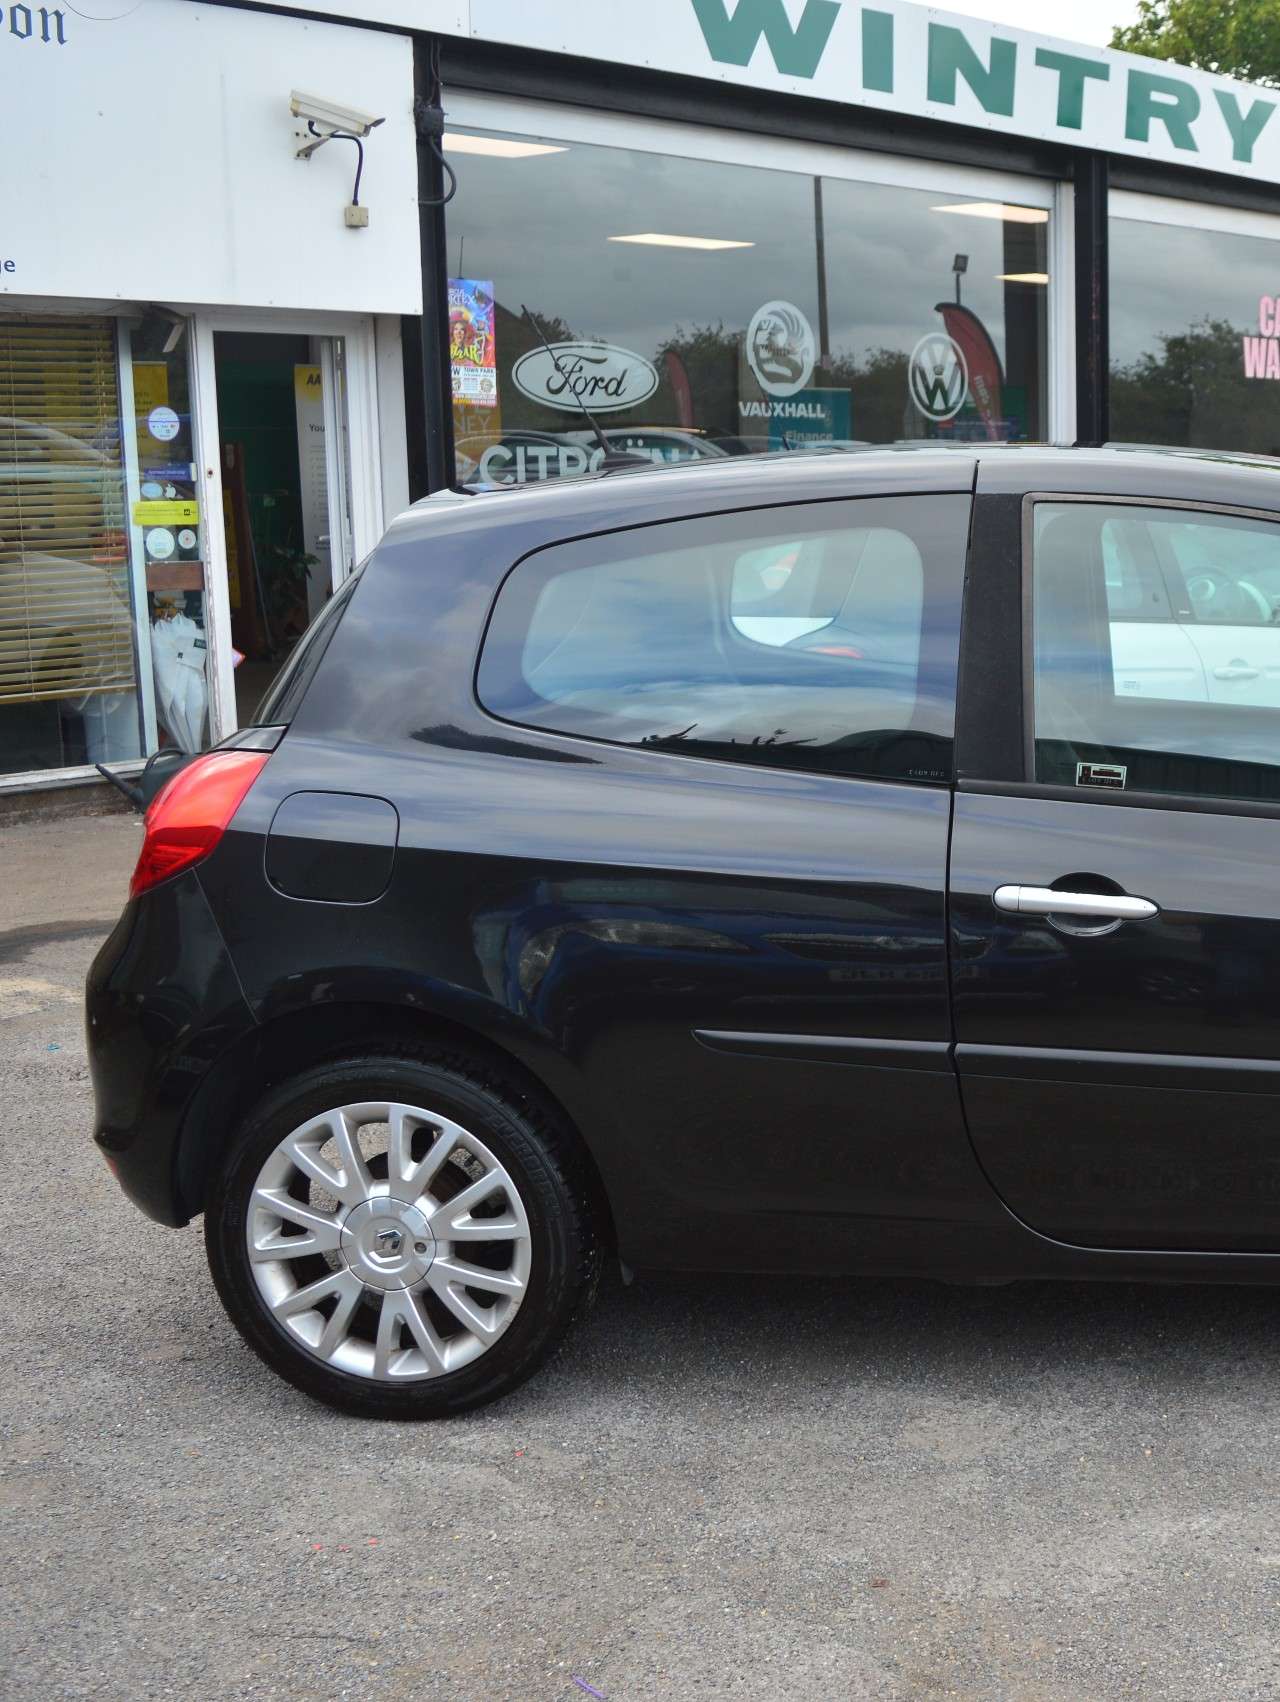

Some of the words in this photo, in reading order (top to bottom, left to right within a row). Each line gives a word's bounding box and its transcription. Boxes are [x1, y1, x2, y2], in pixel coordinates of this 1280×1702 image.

[0, 3, 68, 45] on
[691, 0, 1277, 164] WINTRY
[546, 353, 629, 397] Ford
[738, 400, 827, 419] VAUXHALL
[785, 430, 833, 442] Finance
